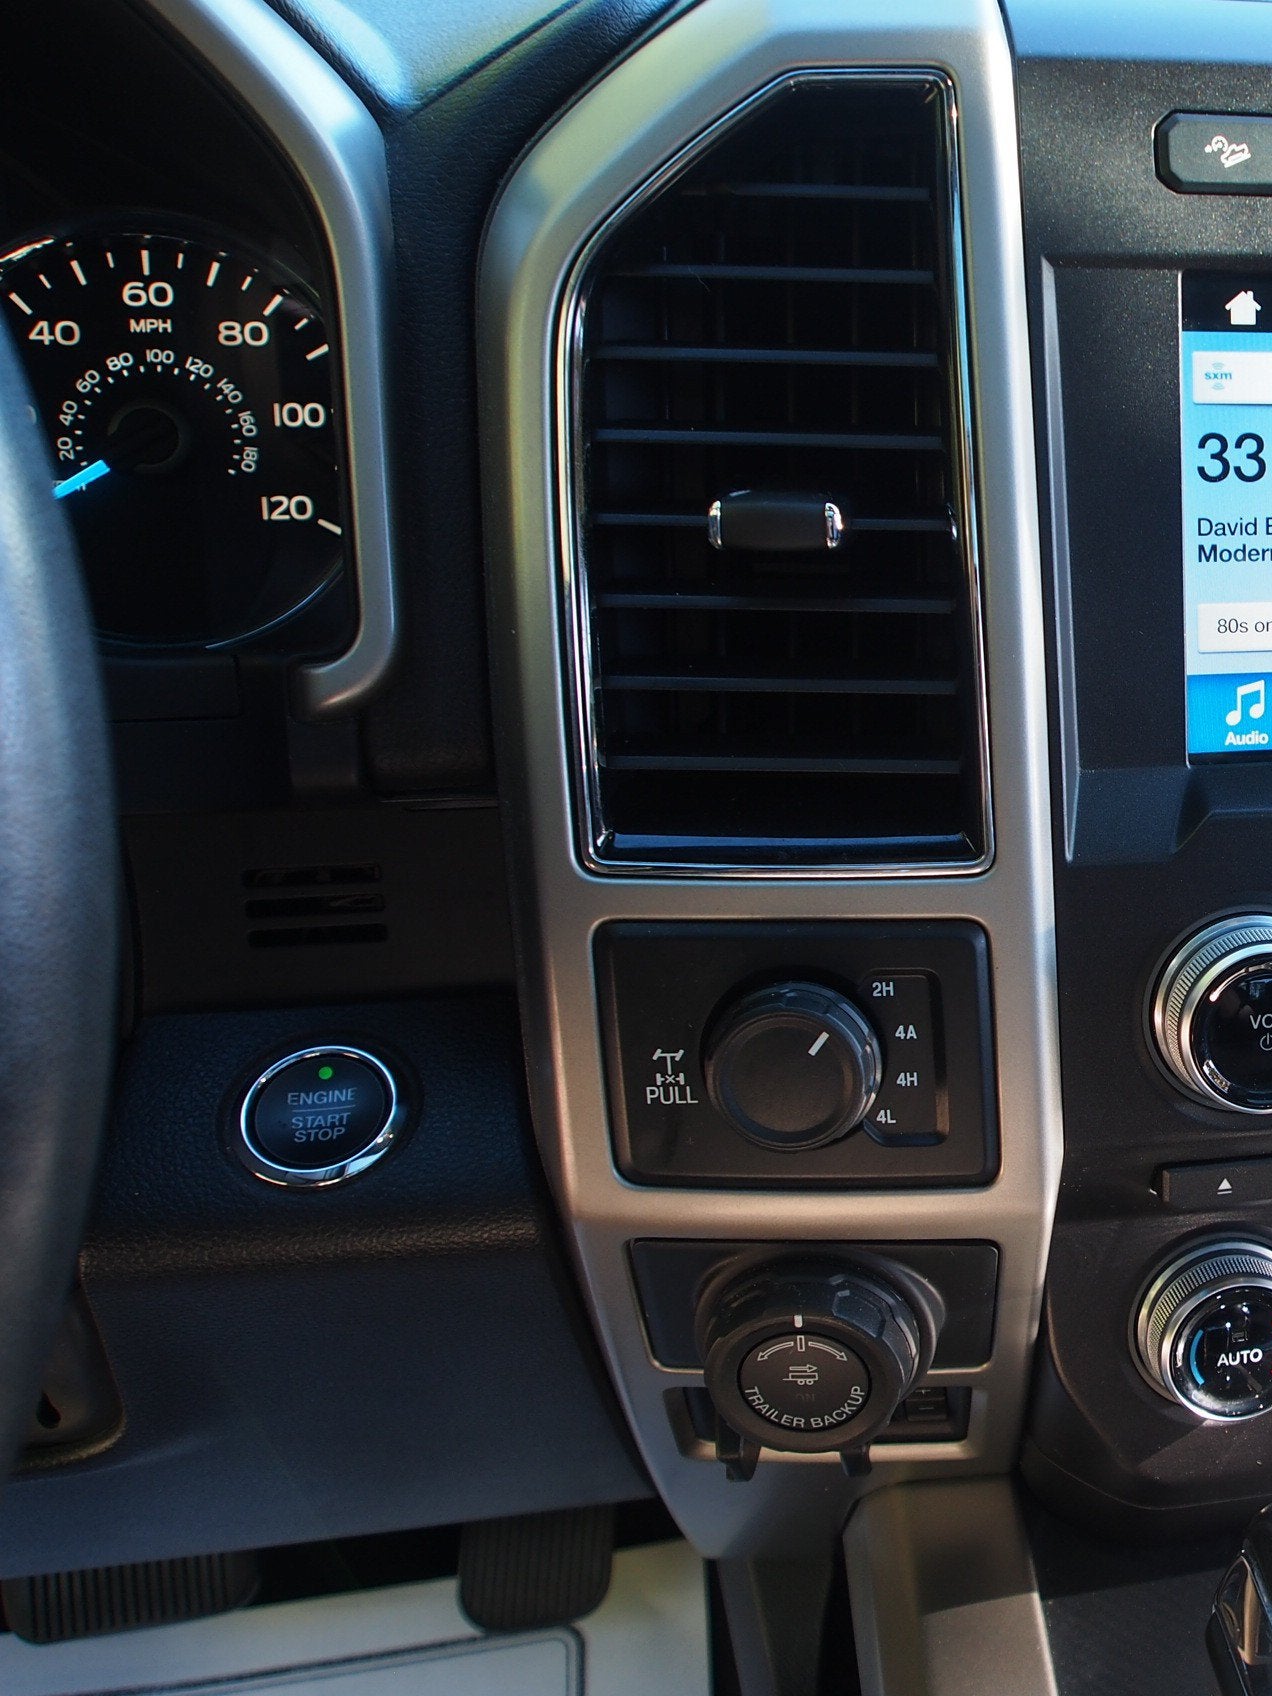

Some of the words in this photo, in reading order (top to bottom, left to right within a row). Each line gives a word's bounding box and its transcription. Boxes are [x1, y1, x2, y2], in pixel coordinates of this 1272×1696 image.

[121, 281, 174, 308] 60
[28, 320, 81, 346] 40
[129, 318, 172, 334] MPH
[217, 321, 269, 347] 80
[105, 352, 134, 372] 80
[146, 348, 174, 365] 100
[184, 356, 214, 379] 120
[75, 369, 100, 394] 60
[216, 377, 243, 405] 140
[58, 400, 78, 427] 40
[237, 410, 259, 438] 160
[273, 402, 325, 428] 100
[57, 436, 75, 462] 20
[241, 446, 259, 473] 180
[1196, 432, 1267, 483] 33
[261, 495, 313, 521] 120
[1197, 516, 1258, 537] David
[1217, 617, 1249, 635] 80s
[1225, 730, 1269, 746] Audio
[872, 982, 894, 997] 2H
[895, 1025, 917, 1040] 4A
[896, 1072, 918, 1087] 4H
[287, 1087, 358, 1106] ENGINE
[646, 1086, 698, 1104] PULL
[291, 1112, 351, 1130] START
[876, 1109, 896, 1124] 4L
[294, 1126, 345, 1143] STOP
[1217, 1348, 1263, 1367] AUTO
[744, 1386, 805, 1428] TRAILER
[810, 1385, 867, 1428] BACKUP
